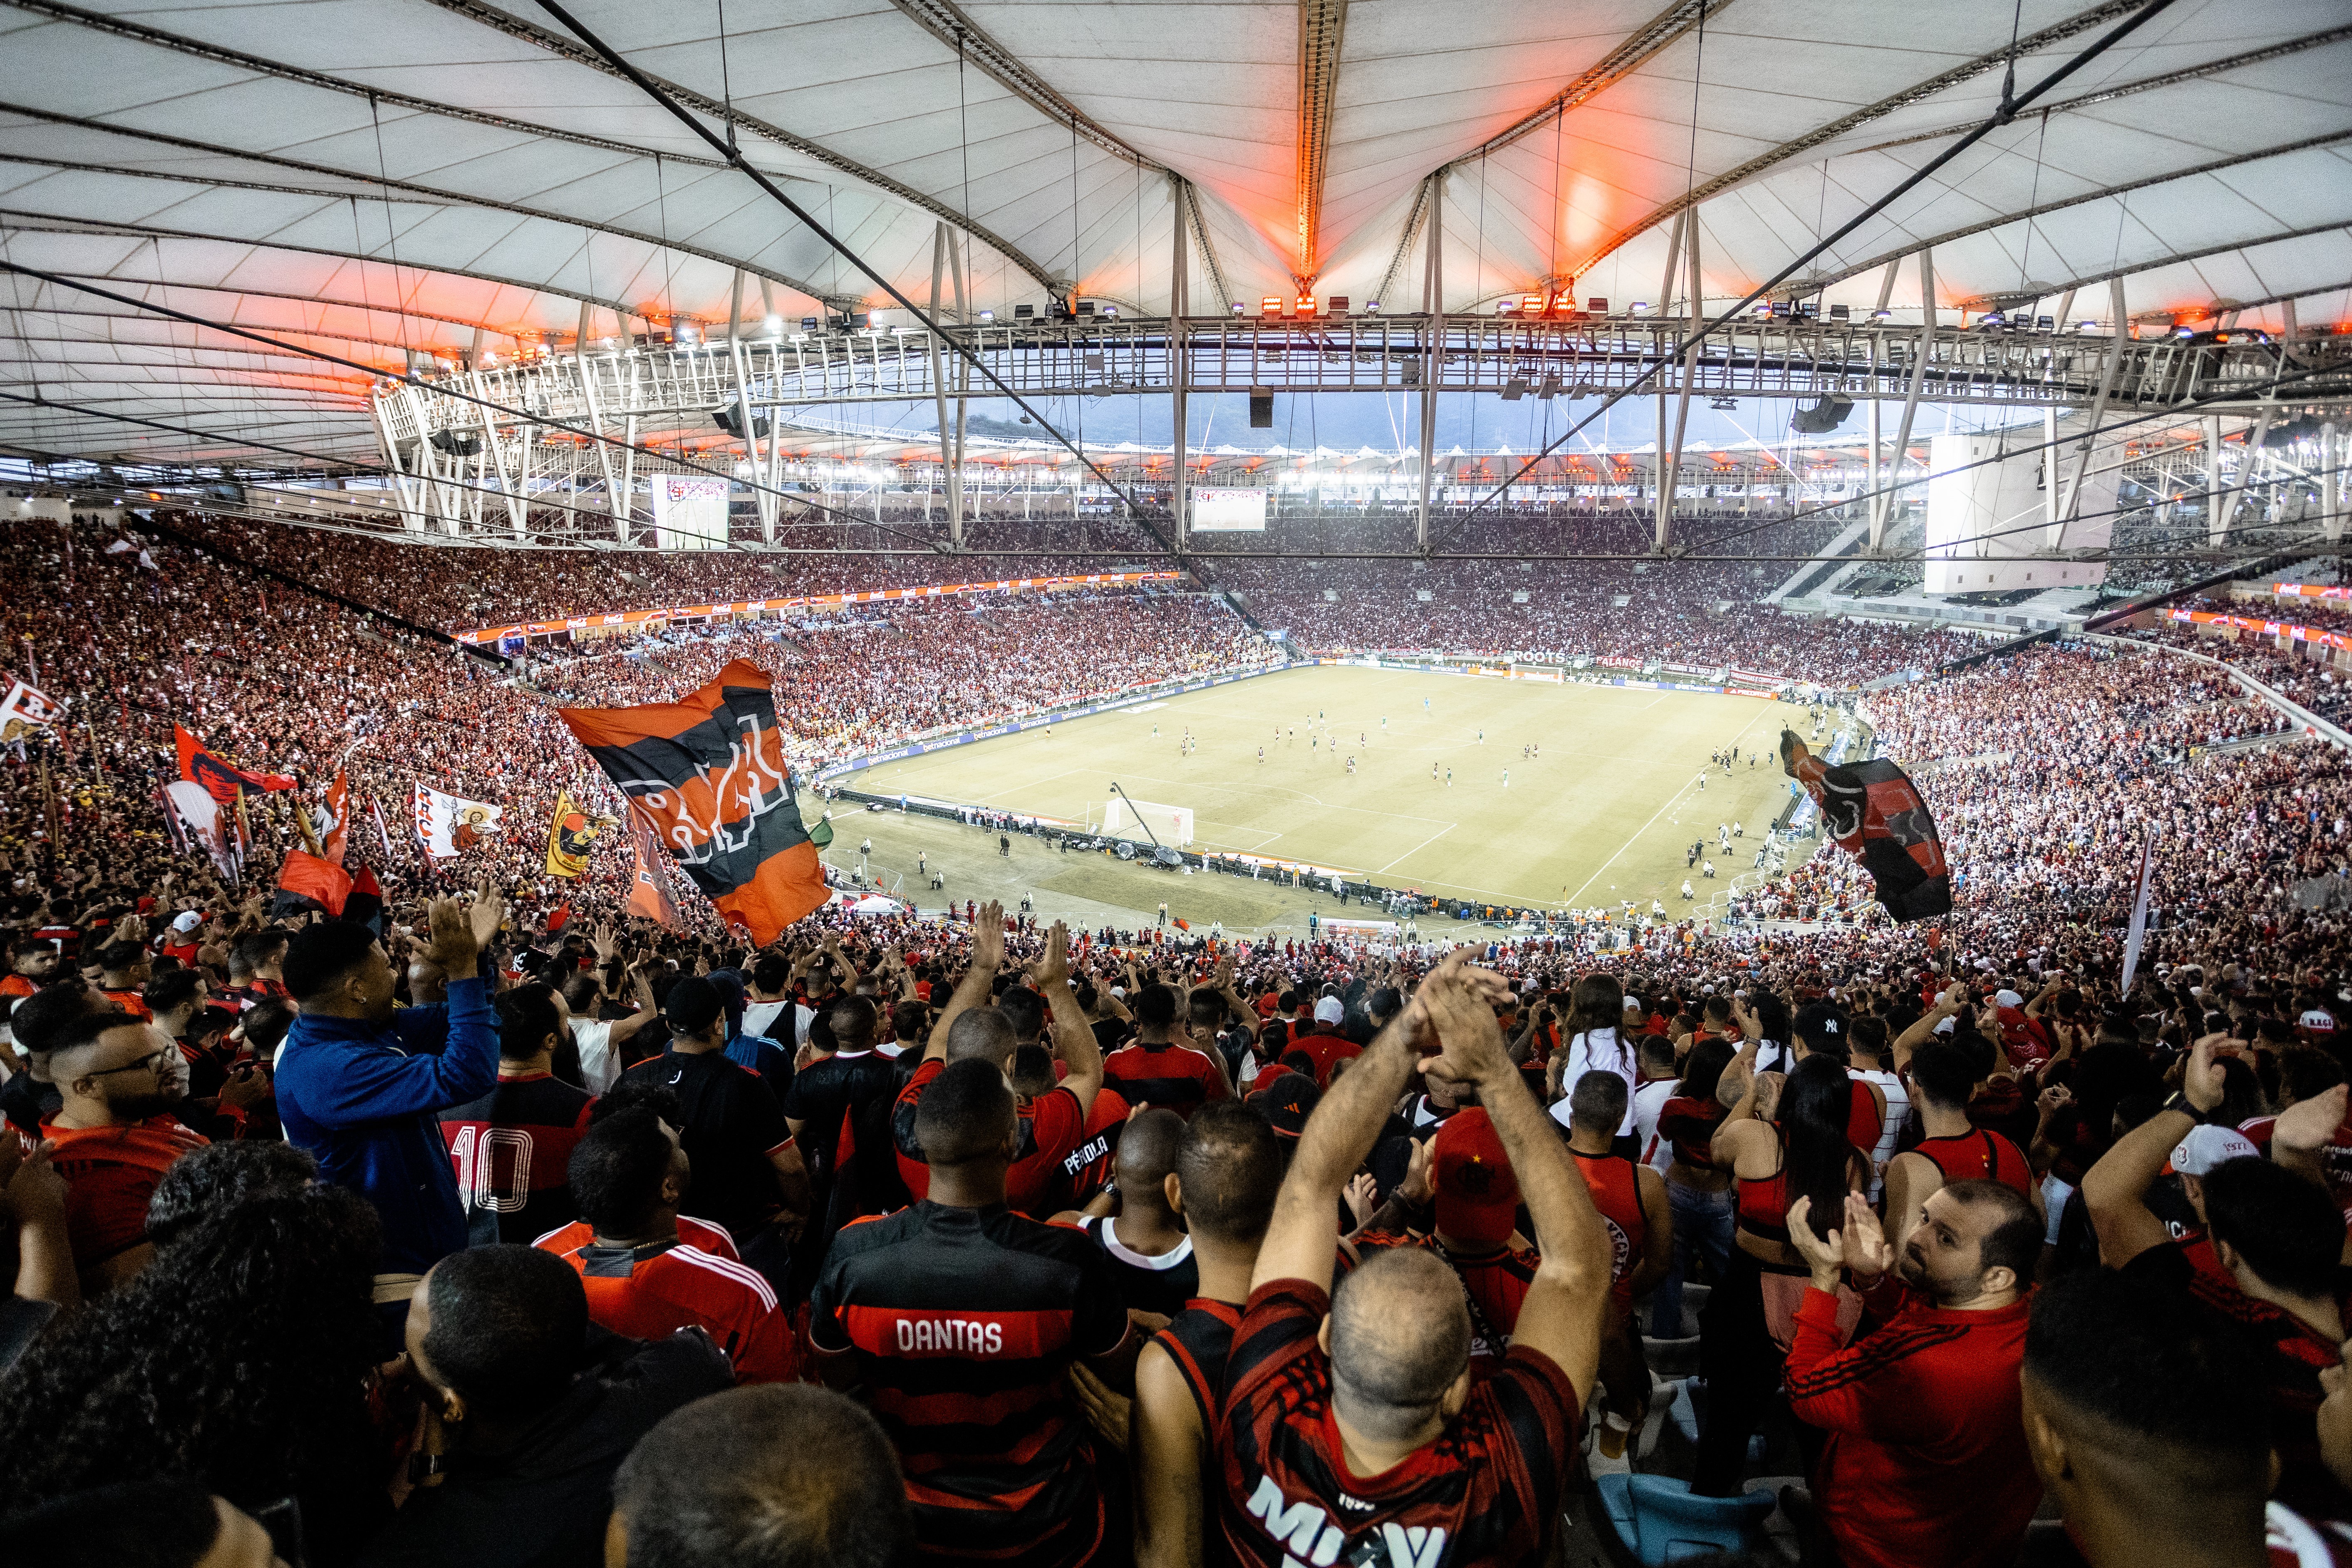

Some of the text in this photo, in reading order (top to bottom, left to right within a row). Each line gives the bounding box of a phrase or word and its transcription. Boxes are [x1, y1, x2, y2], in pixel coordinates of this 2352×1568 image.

[1513, 650, 1566, 663] ROOTS
[1596, 656, 1643, 668] FALANGE
[1737, 689, 1772, 699] PREDATOR
[1061, 708, 1091, 721] betnacional
[1019, 716, 1051, 730] betnacional
[973, 726, 1008, 741] betnacional
[923, 737, 961, 753] betnacional
[867, 748, 909, 766] betnacional
[819, 762, 854, 781] betnacional
[1825, 1019, 1838, 1033] NY
[1064, 1135, 1108, 1175] PÉROLA
[451, 1126, 533, 1214] 10
[897, 1319, 1002, 1354] DANTAS
